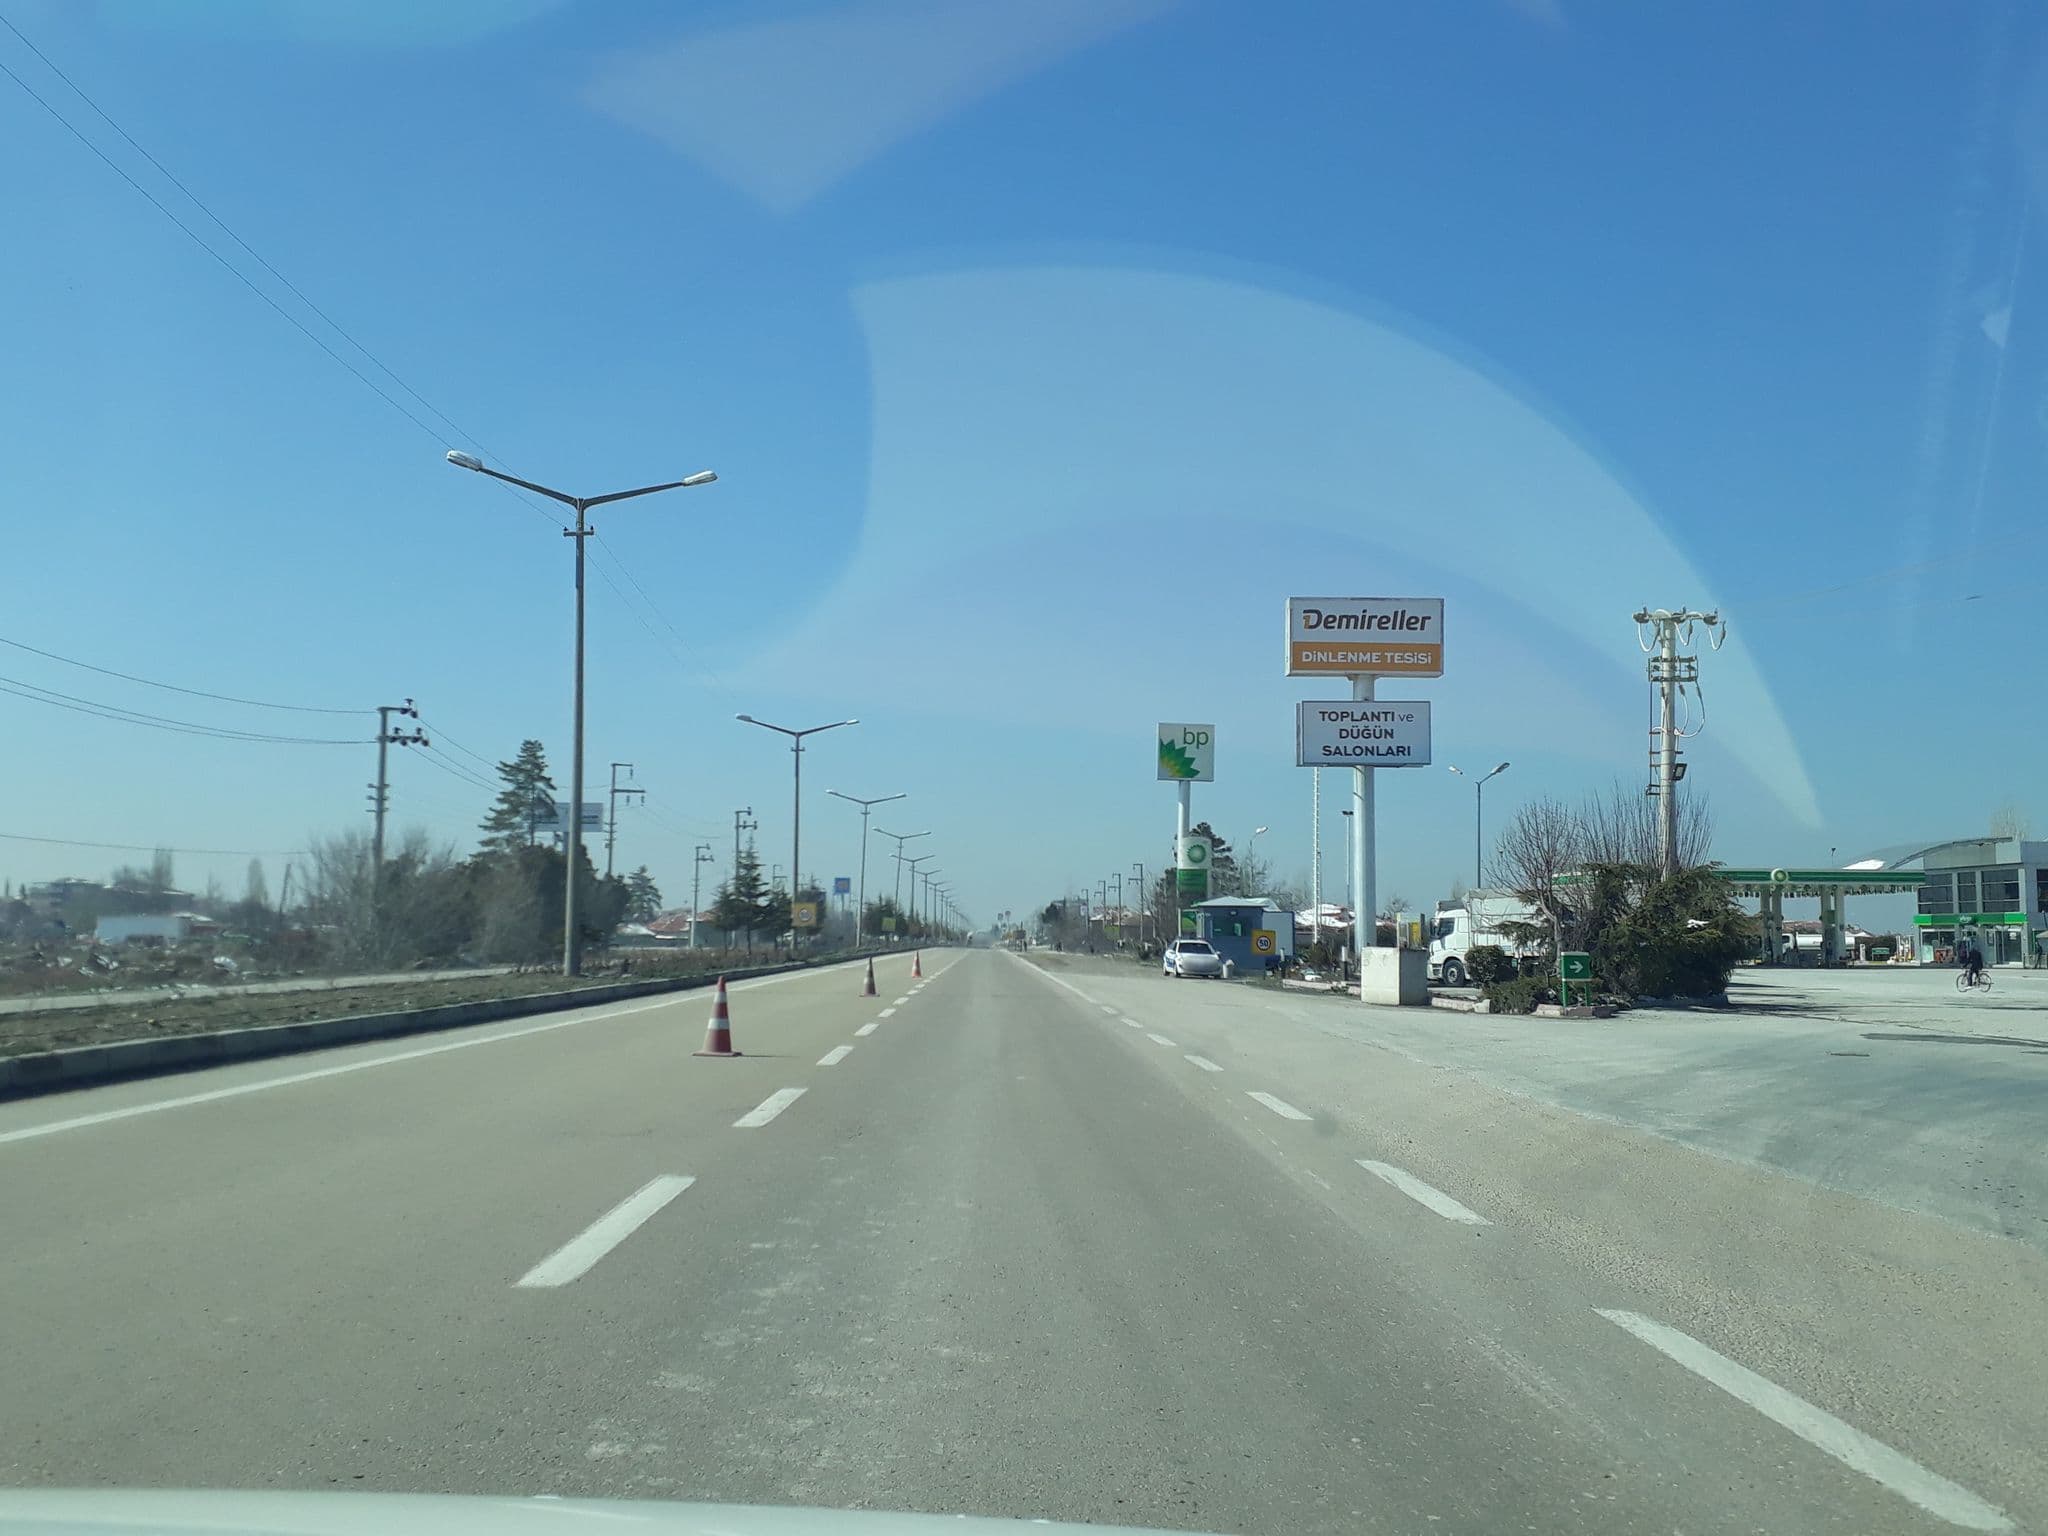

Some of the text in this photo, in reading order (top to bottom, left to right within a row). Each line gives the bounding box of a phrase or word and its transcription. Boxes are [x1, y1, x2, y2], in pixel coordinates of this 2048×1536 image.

[1302, 609, 1431, 631] Demireller
[1302, 651, 1381, 663] DİNLENME
[1319, 711, 1414, 723] TOPLANTI ve
[1183, 727, 1209, 748] bp
[1339, 725, 1394, 739] DÜĞÜN
[1322, 745, 1411, 757] SALONLARI
